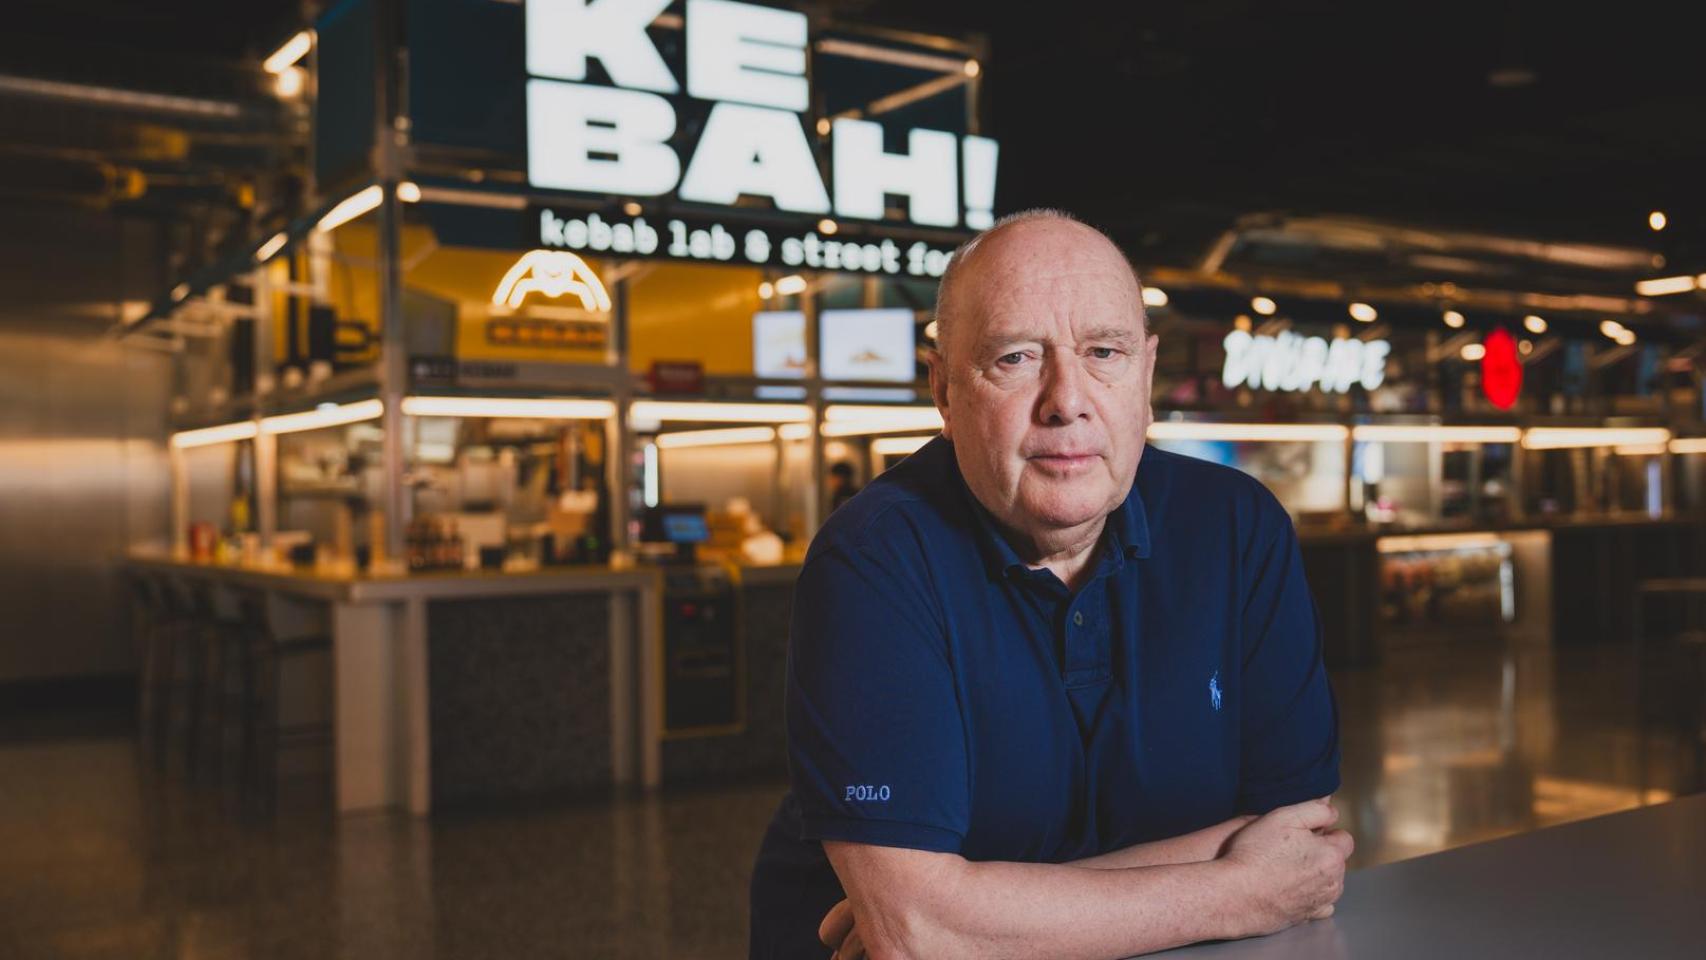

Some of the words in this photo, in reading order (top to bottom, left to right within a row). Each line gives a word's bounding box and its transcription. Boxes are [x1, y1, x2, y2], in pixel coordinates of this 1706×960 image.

[525, 0, 808, 112] KE
[526, 78, 999, 231] BAH!
[540, 209, 659, 254] kebab
[668, 219, 736, 261] lab
[781, 233, 900, 274] street
[845, 785, 890, 801] POLO
